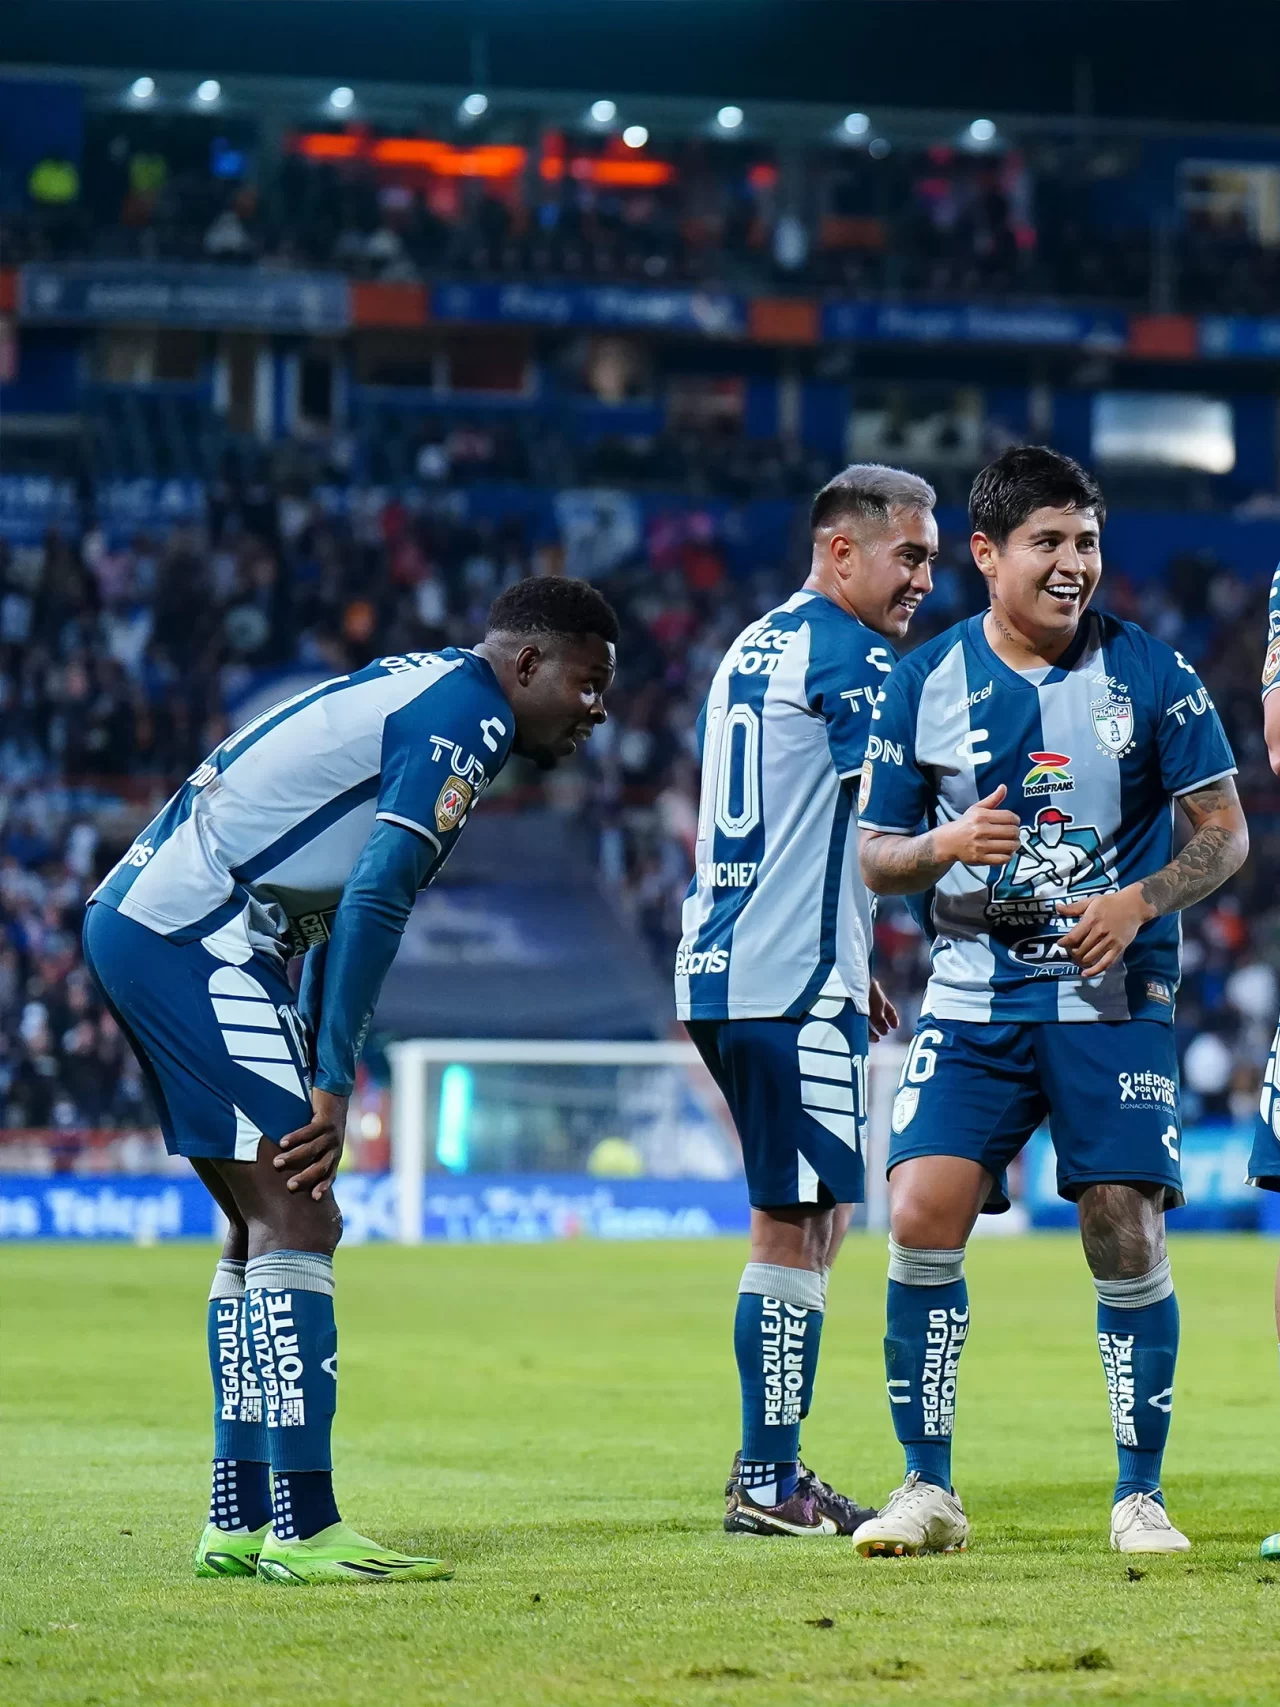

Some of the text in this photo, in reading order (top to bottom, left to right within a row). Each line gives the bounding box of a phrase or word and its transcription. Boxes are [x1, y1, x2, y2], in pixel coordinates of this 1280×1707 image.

[957, 680, 993, 715] telcel
[1094, 705, 1129, 718] PACHUCA
[1025, 781, 1074, 796] ROSHFRANS
[675, 944, 729, 976] etcris
[1023, 942, 1068, 960] JA
[1133, 1069, 1175, 1093] HÉROES
[1134, 1085, 1151, 1093] POR
[217, 1298, 240, 1420] PEGAZULEJ
[265, 1288, 304, 1399] FORTE
[940, 1305, 969, 1415] FORTEC
[760, 1296, 782, 1425] PEGAZULEJO
[921, 1309, 949, 1436] PEGAZULEJO
